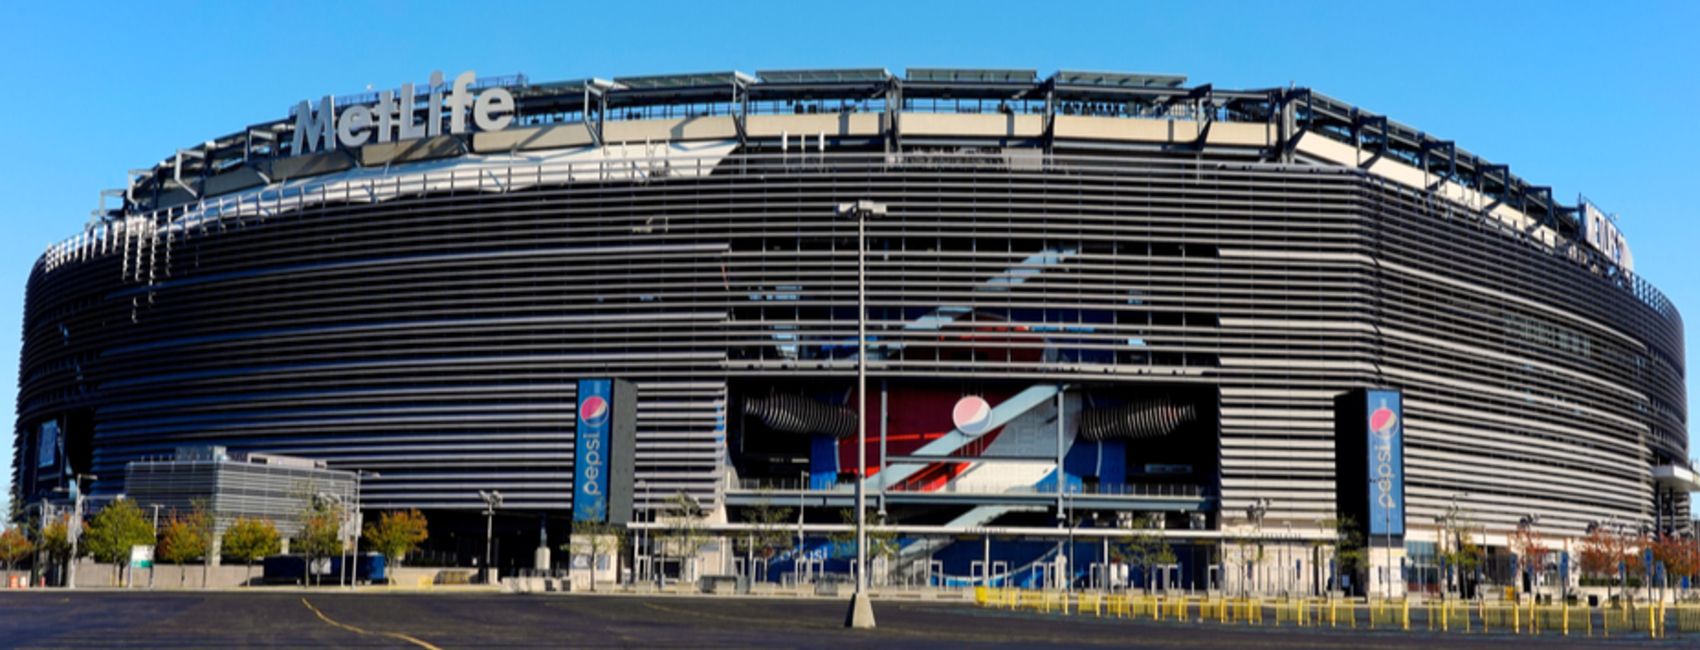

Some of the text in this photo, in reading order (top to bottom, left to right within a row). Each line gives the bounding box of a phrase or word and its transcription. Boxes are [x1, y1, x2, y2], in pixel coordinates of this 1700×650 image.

[291, 70, 515, 156] MetLife
[583, 432, 601, 495] pepsi
[1375, 444, 1396, 509] pepsi
